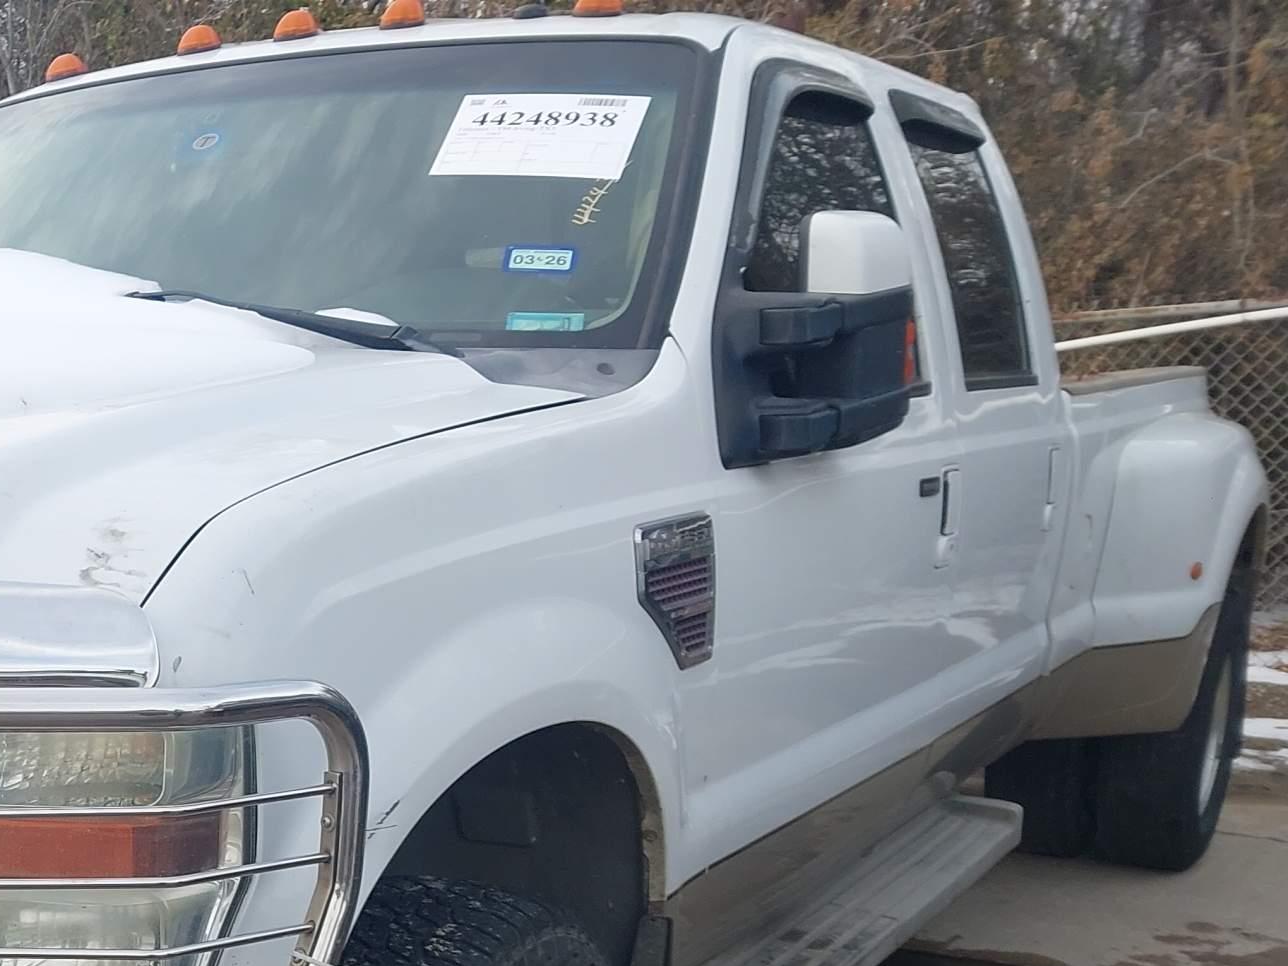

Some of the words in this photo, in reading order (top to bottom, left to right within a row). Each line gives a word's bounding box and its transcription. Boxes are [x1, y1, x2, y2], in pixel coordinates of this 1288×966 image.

[471, 111, 618, 127] 44248938
[513, 254, 535, 265] 03
[544, 255, 568, 266] 26
